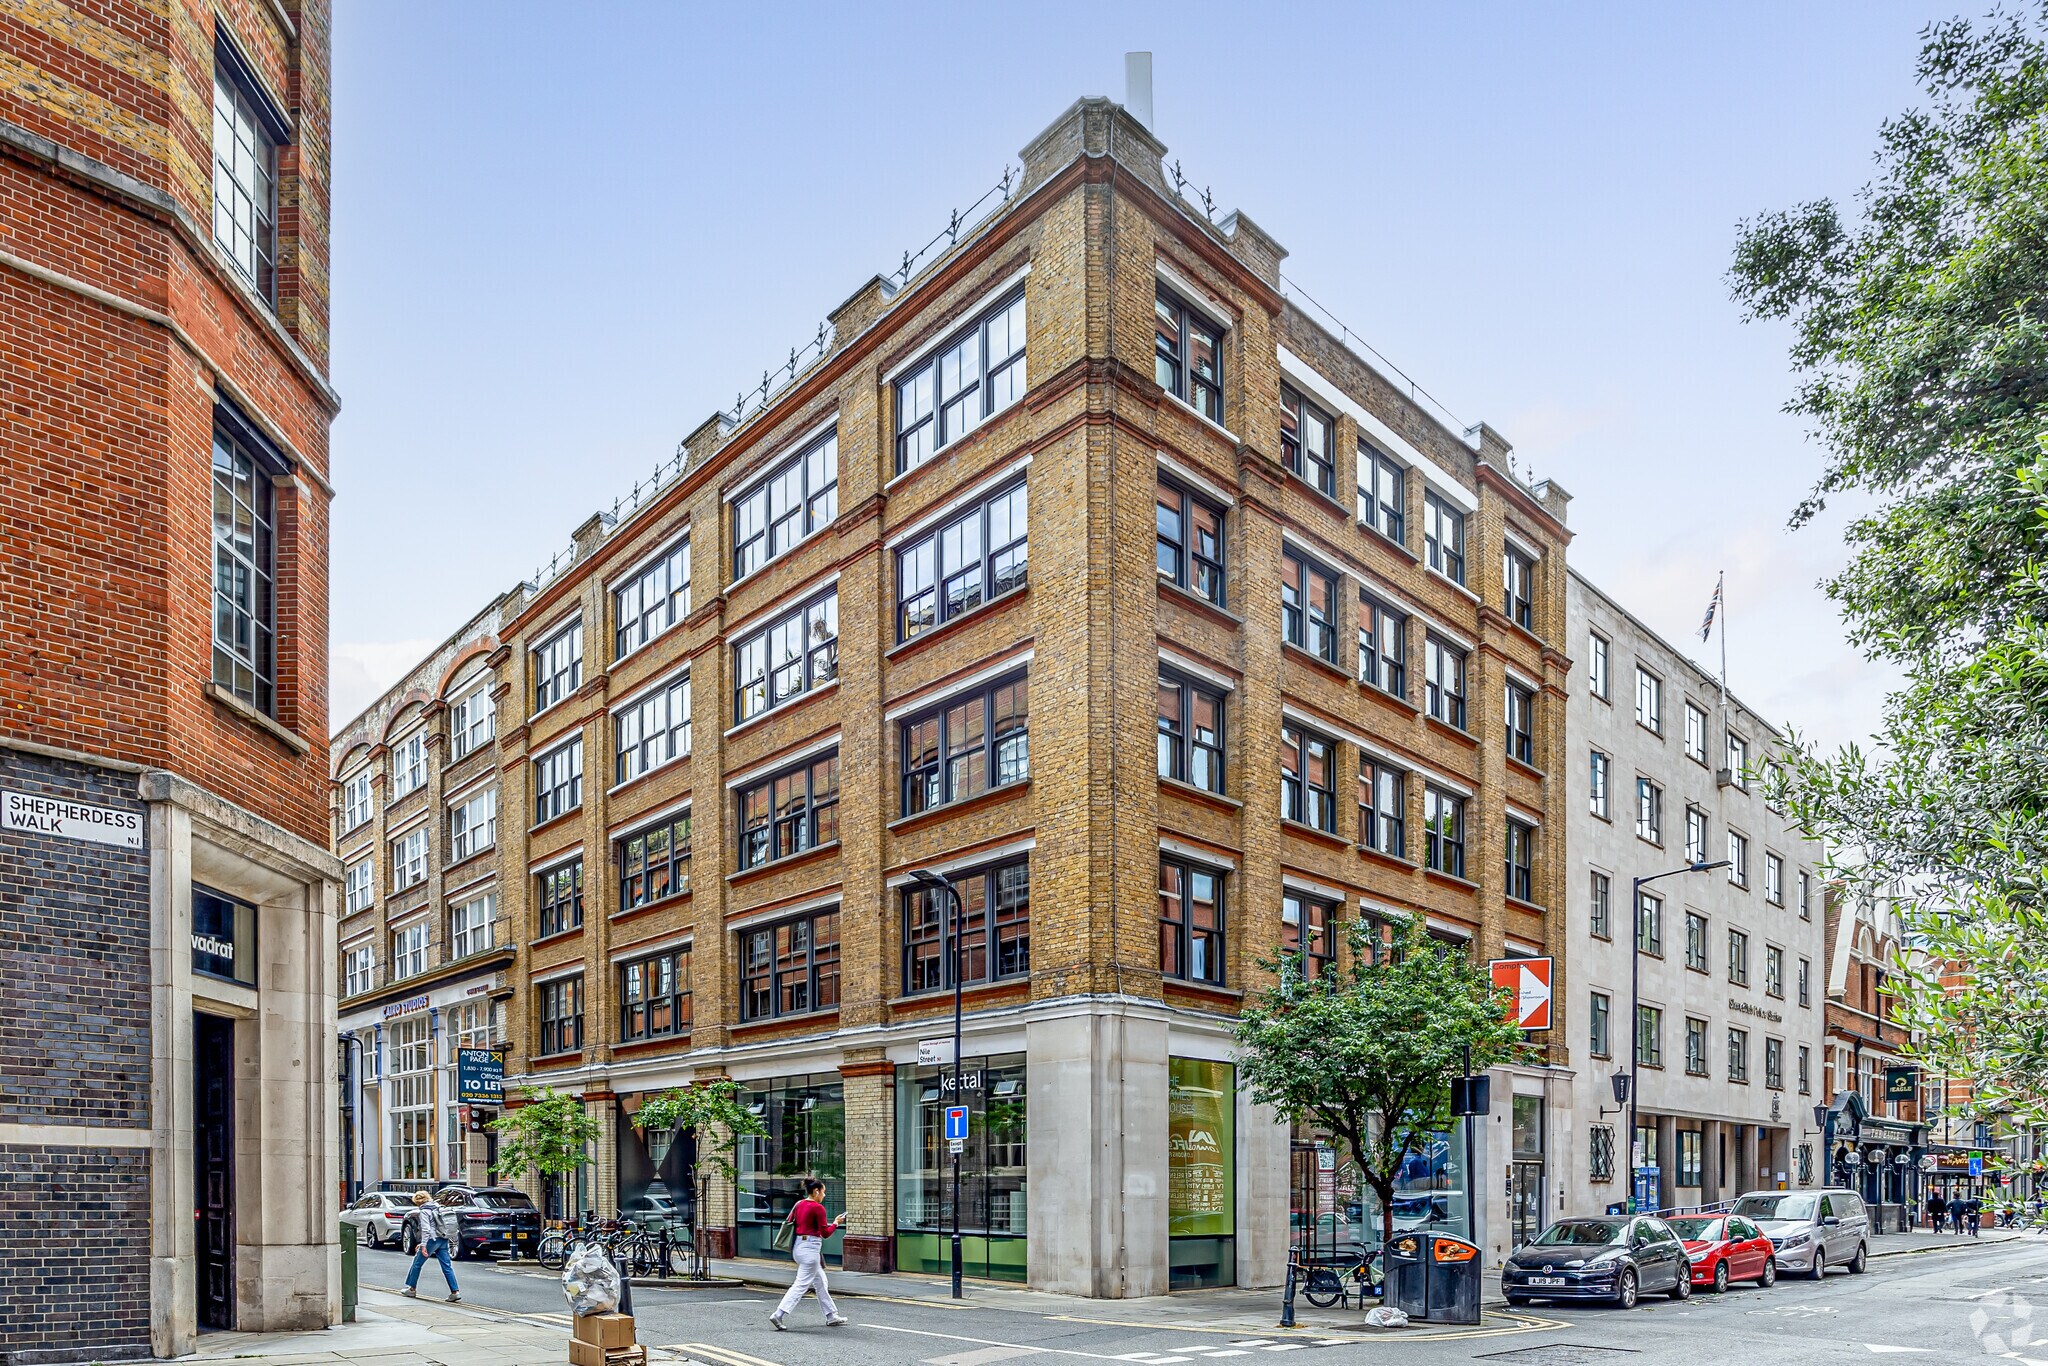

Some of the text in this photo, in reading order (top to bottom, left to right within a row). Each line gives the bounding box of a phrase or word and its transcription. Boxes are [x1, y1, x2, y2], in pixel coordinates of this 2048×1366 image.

[10, 796, 136, 829] SHEPHERDESS
[10, 811, 62, 833] WALK
[190, 934, 233, 960] vadrat
[403, 995, 430, 1014] STUDIOS
[919, 1048, 931, 1056] Nile
[919, 1055, 936, 1063] Street
[464, 1080, 501, 1091] TO LET
[941, 1070, 980, 1091] ketal
